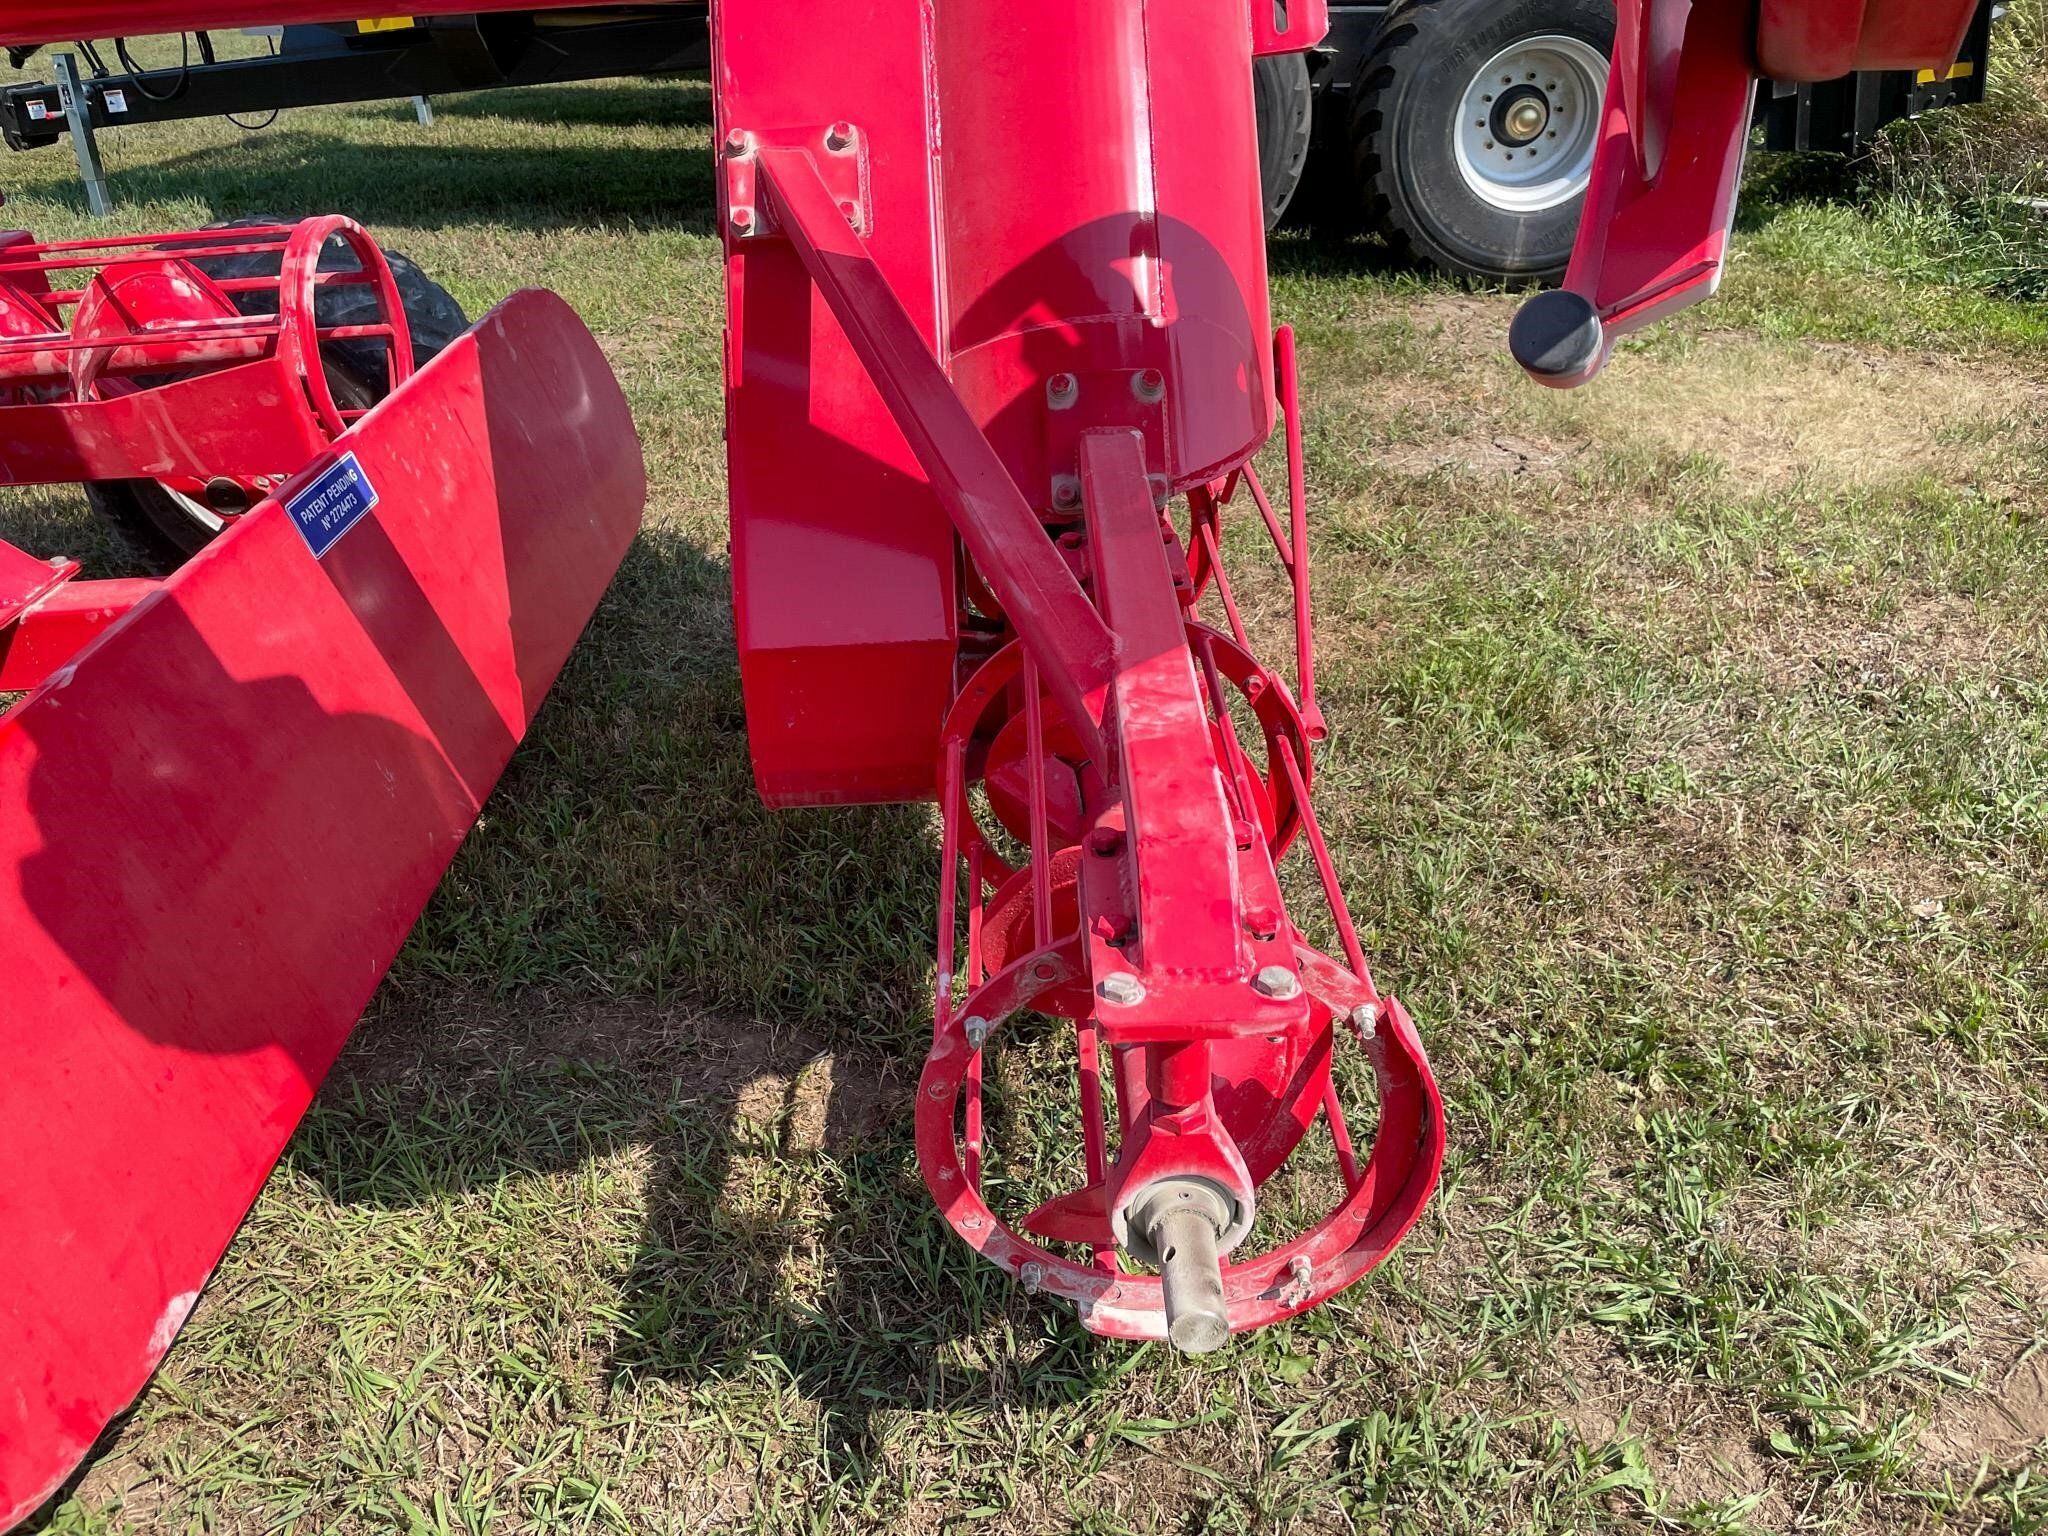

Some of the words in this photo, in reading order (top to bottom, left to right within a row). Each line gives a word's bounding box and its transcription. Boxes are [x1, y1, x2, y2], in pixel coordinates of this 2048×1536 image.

[300, 492, 330, 525] PATENT
[326, 468, 358, 502] PENDING
[329, 492, 358, 523] 2724473
